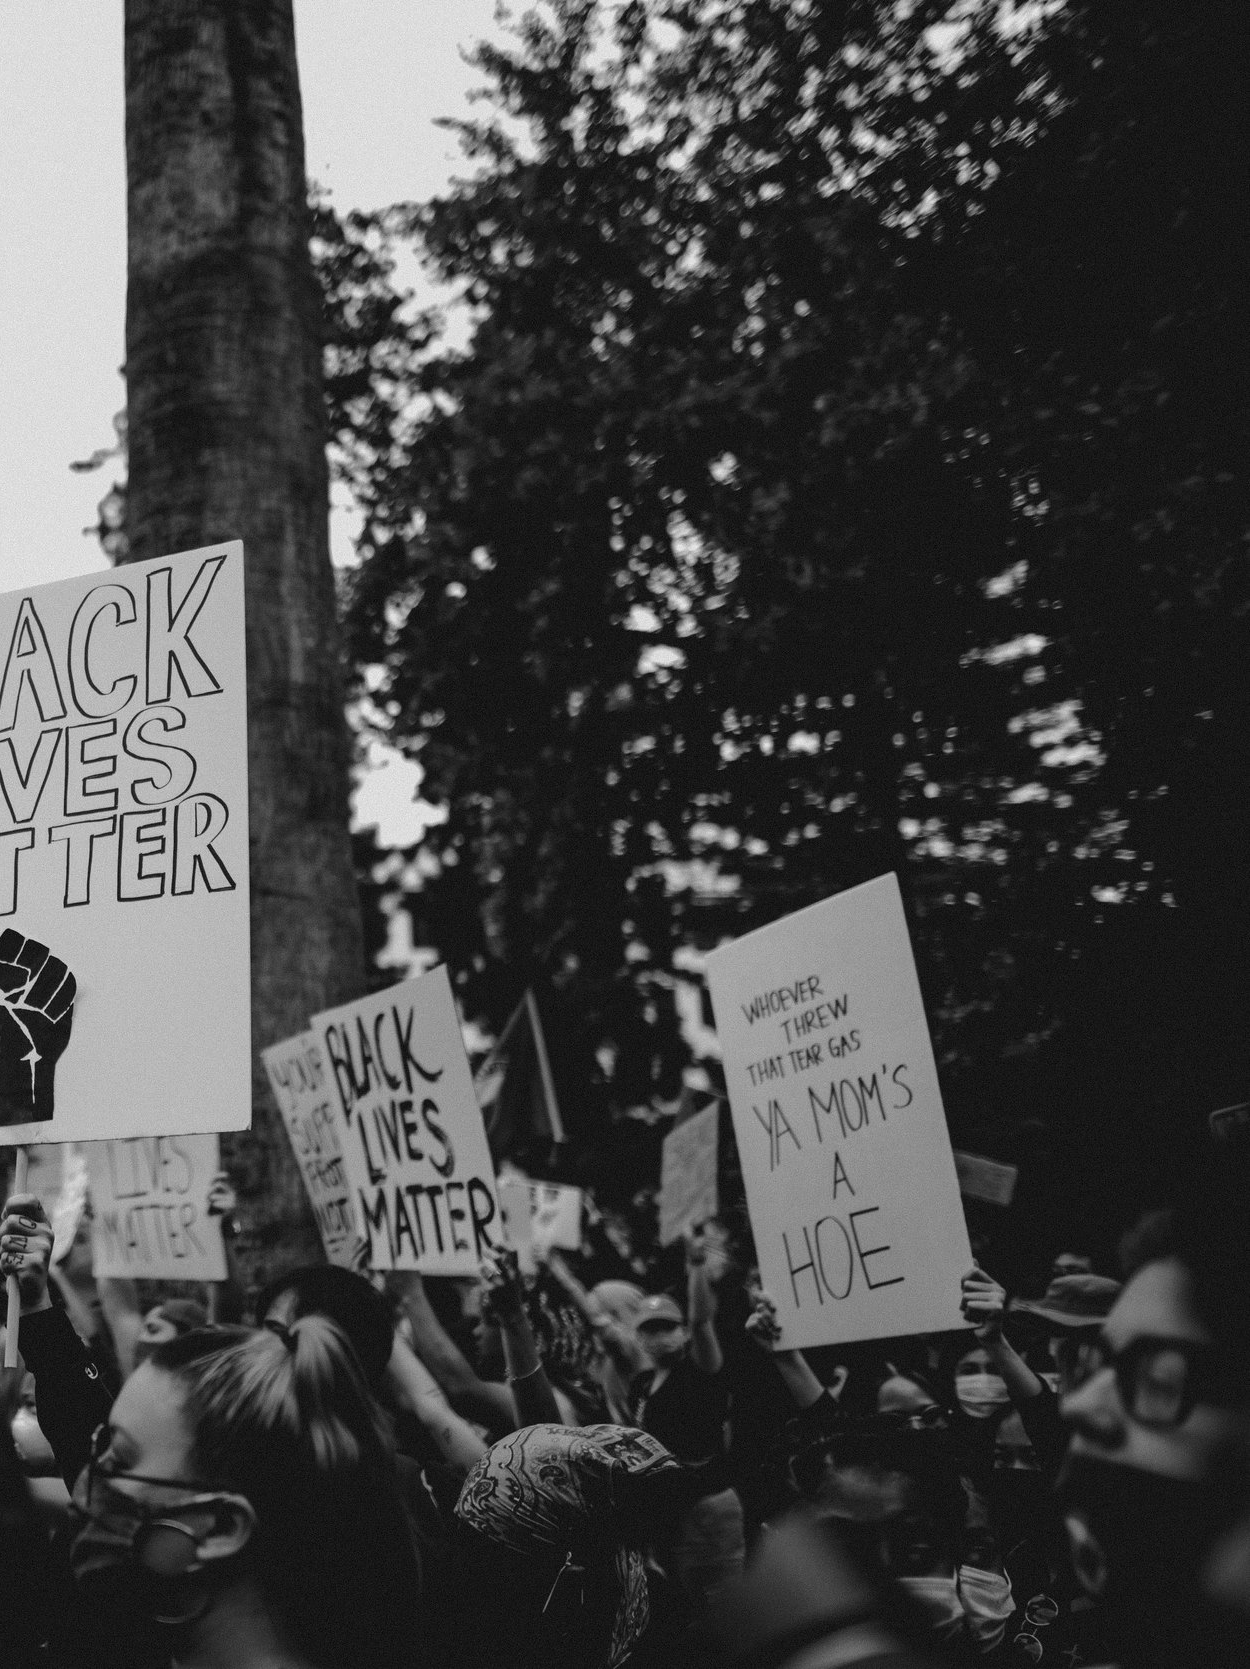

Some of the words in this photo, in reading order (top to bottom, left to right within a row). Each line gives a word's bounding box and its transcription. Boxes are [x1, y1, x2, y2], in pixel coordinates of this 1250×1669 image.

[741, 975, 824, 1025] WHOEVER
[780, 993, 848, 1044] THREW
[325, 1005, 443, 1126] BLACK
[746, 1054, 786, 1087] THAT
[788, 1042, 824, 1074] TEAR
[828, 1029, 861, 1058] GAS
[358, 1098, 455, 1186] LIVES
[752, 1099, 801, 1172] YA
[808, 1063, 913, 1143] MOM'S
[833, 1151, 855, 1199] A
[103, 1203, 206, 1264] MATTER
[358, 1177, 499, 1267] MATTER
[781, 1206, 905, 1308] HOE
